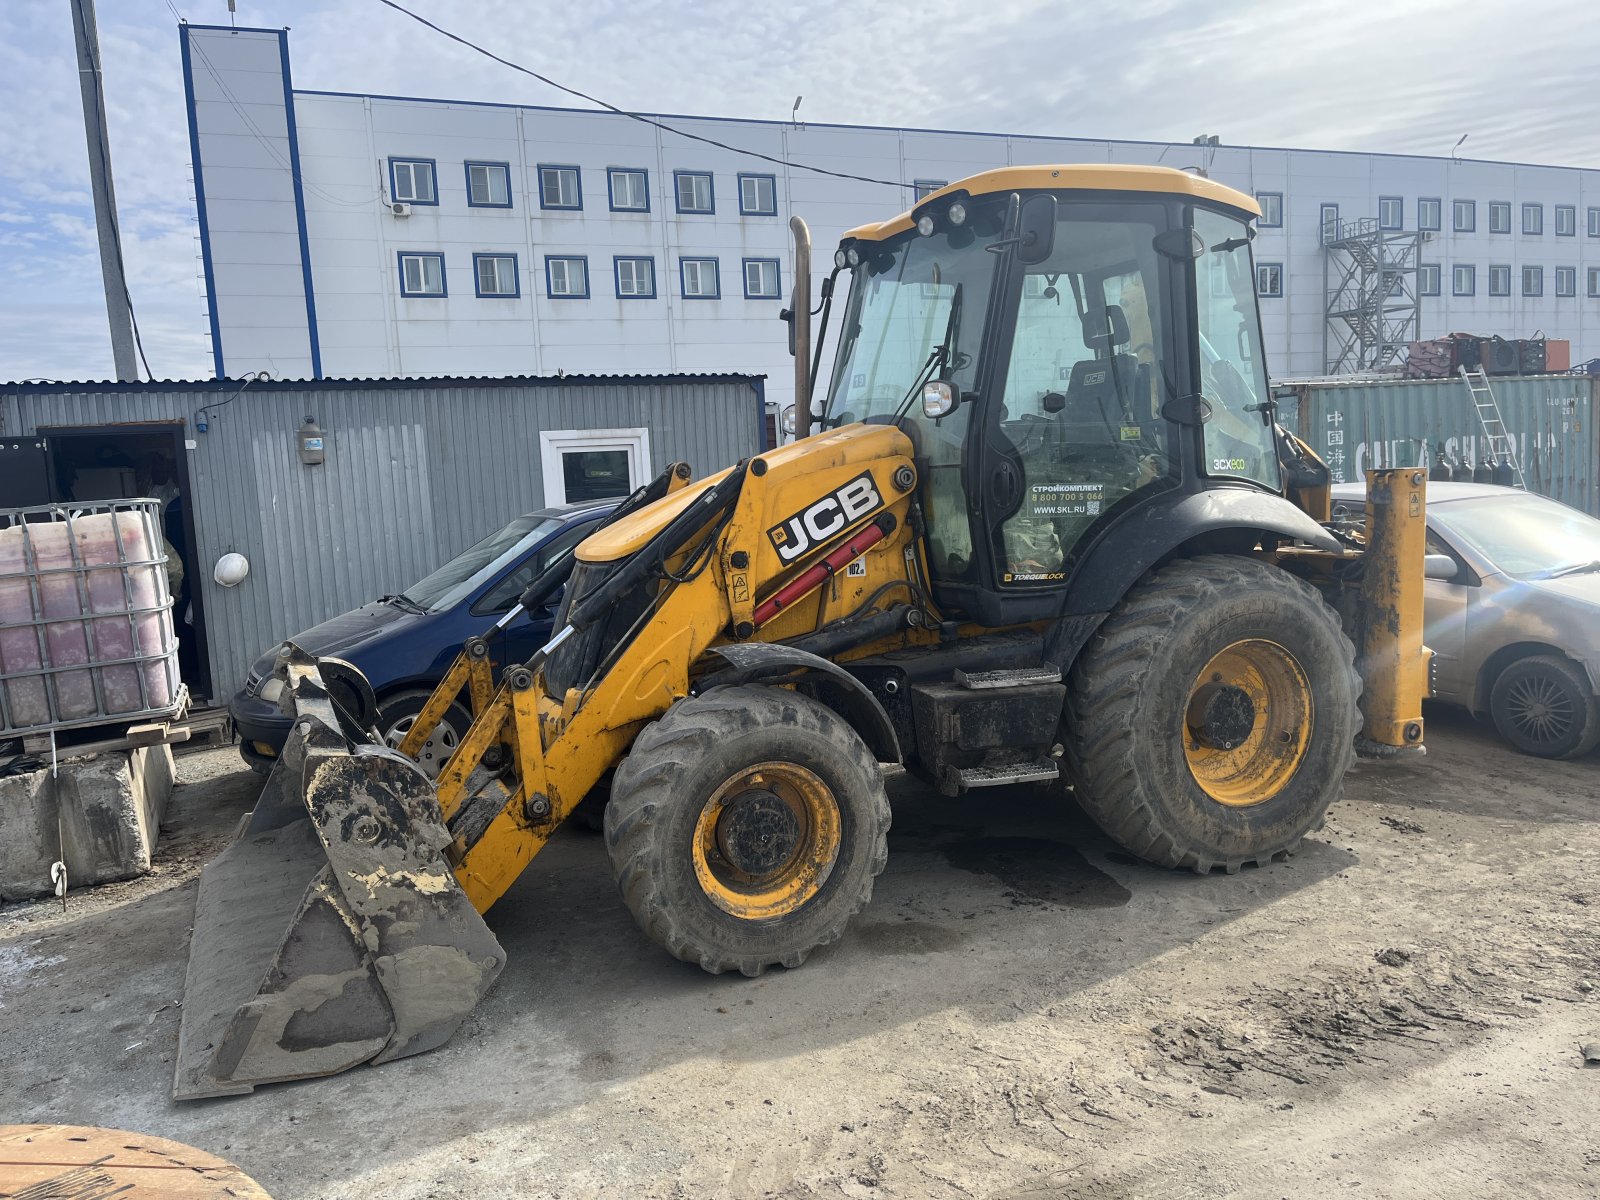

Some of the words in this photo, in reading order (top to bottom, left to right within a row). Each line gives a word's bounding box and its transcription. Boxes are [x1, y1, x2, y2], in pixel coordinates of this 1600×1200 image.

[1086, 374, 1104, 384] JCB
[1032, 484, 1103, 493] СТРОЙКОМПЛЕКТ
[1060, 493, 1076, 501] 700
[1087, 492, 1103, 500] 066
[1033, 506, 1086, 514] WWW.SKL.RU
[778, 477, 879, 560] JCB
[849, 563, 860, 575] 102
[1013, 572, 1066, 581] TORQUELOCK
